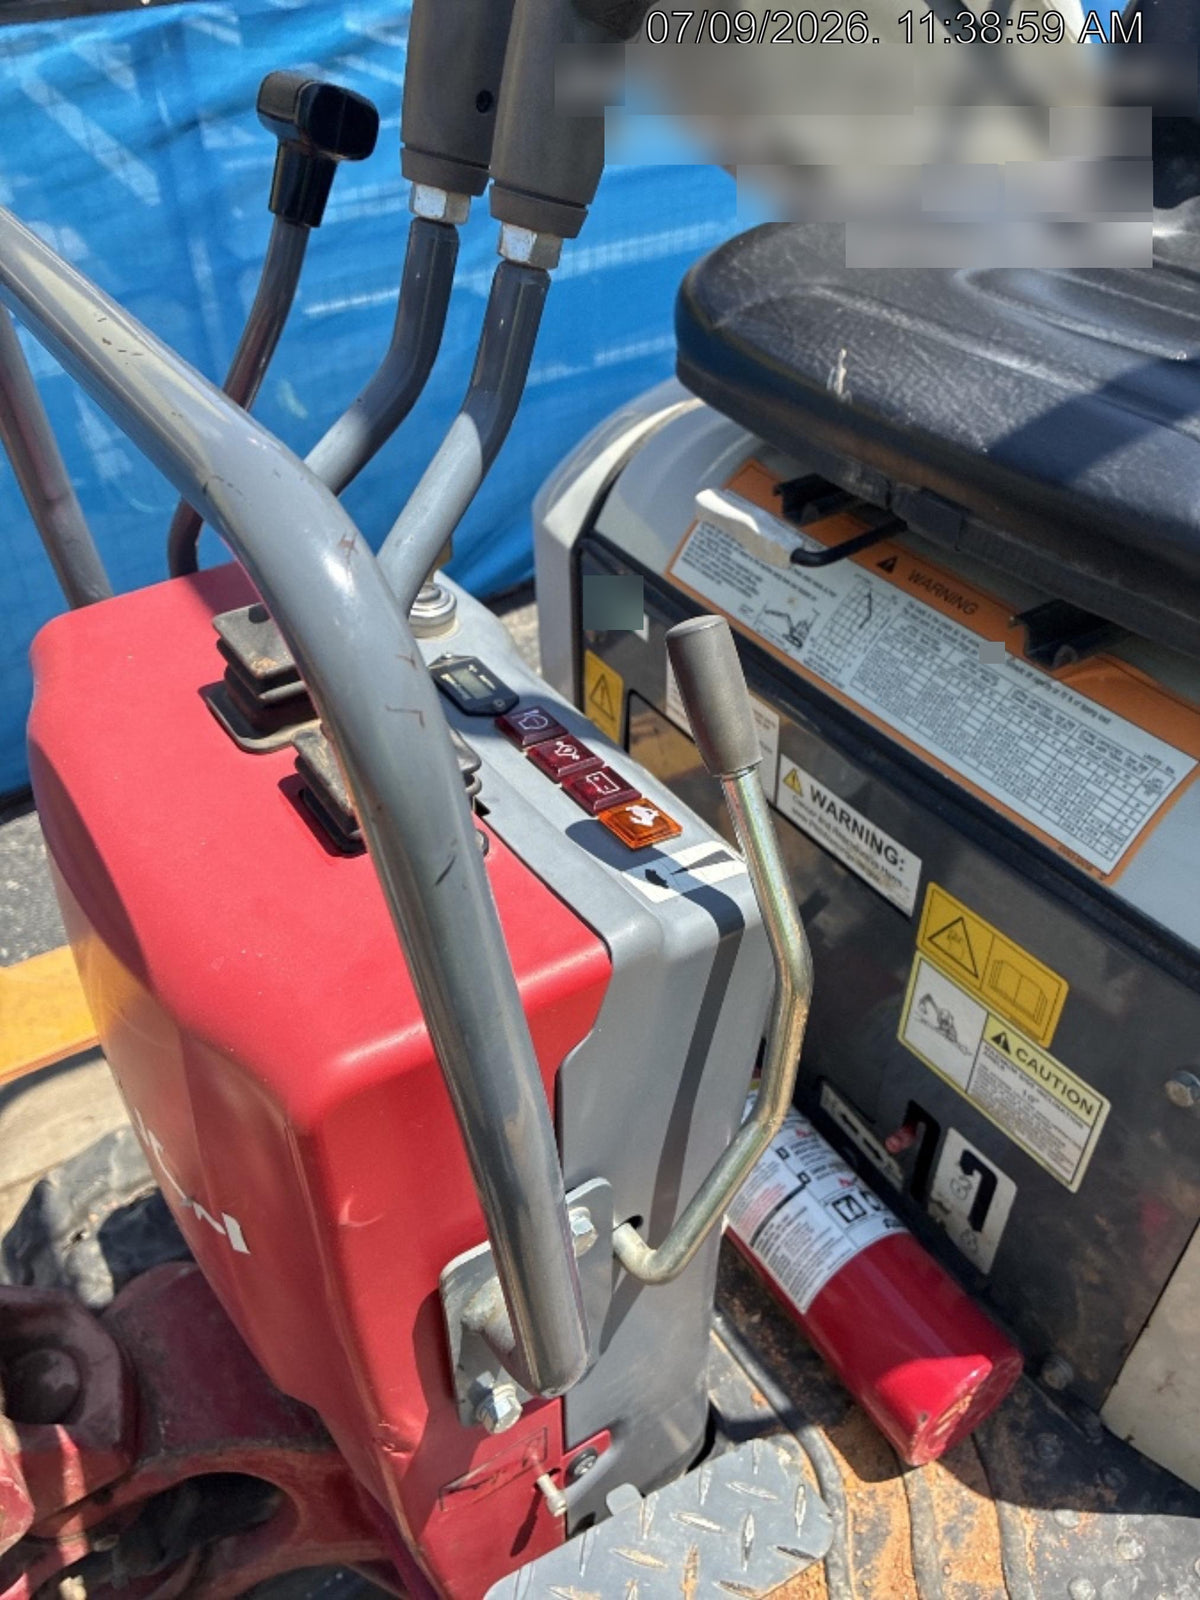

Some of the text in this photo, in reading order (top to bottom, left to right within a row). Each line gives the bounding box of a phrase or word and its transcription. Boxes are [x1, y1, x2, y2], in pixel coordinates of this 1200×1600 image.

[908, 570, 978, 615] WARNING
[809, 783, 904, 873] WARNING:
[1016, 1048, 1094, 1115] CAUTION
